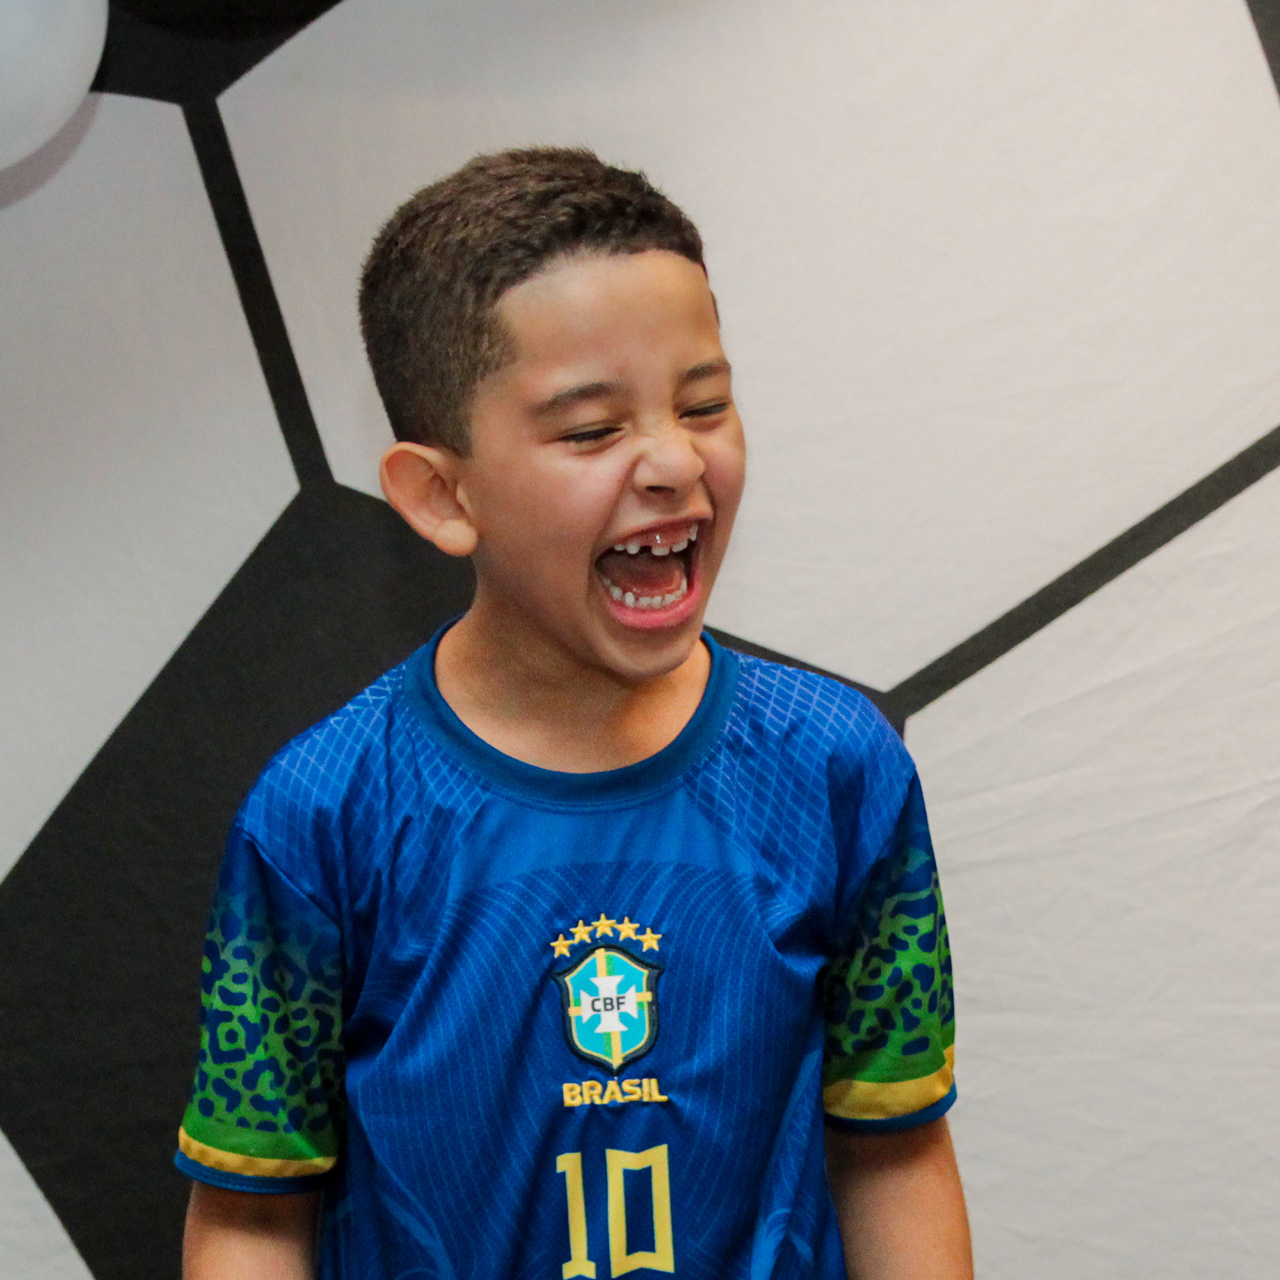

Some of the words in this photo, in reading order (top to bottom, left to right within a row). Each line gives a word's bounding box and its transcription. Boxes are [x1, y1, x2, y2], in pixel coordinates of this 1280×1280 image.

[590, 995, 627, 1013] CBF
[562, 1077, 669, 1108] BRASIL
[556, 1144, 675, 1280] 10
